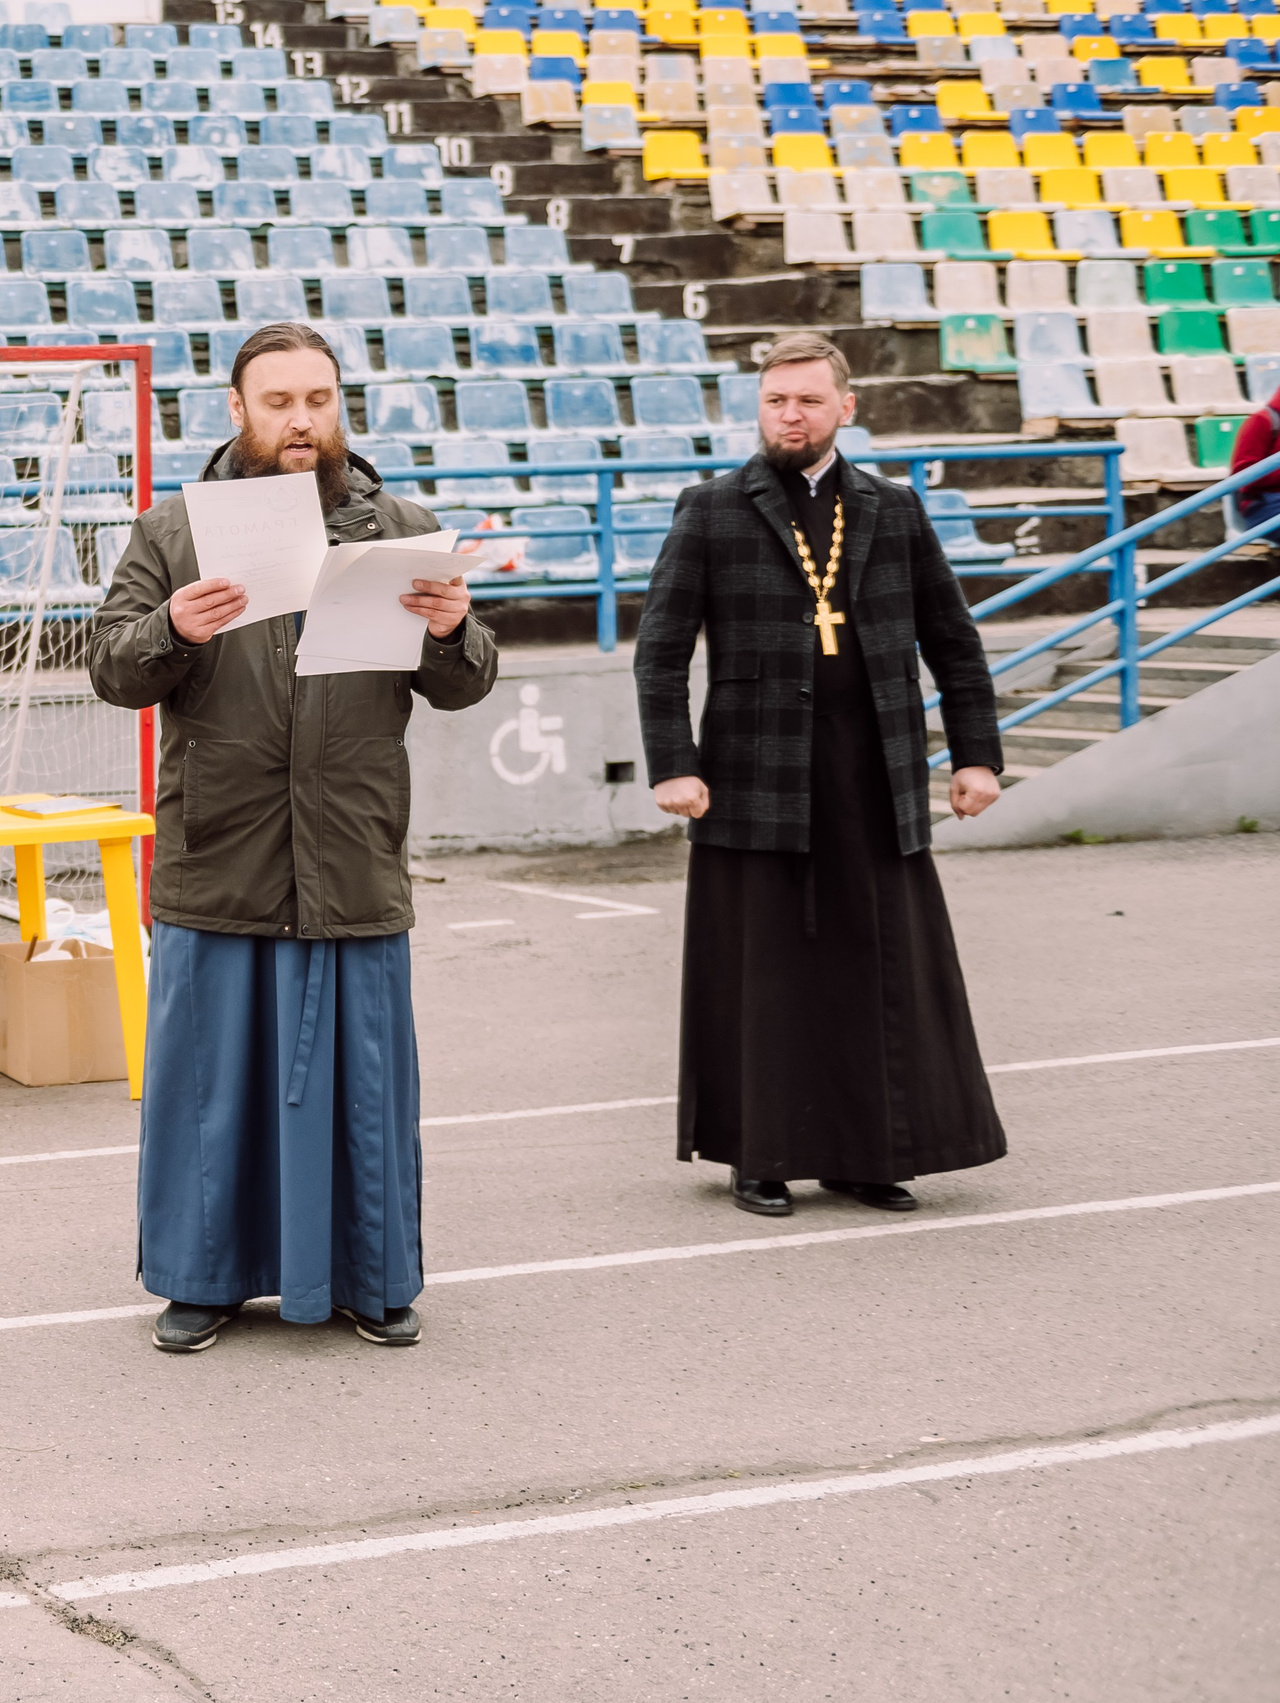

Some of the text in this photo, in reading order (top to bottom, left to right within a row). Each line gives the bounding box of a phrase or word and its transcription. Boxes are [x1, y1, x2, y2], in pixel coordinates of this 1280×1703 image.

[250, 22, 283, 49] 14
[290, 50, 324, 78] 13
[335, 76, 370, 104] 12
[383, 102, 413, 135] 11
[434, 136, 472, 167] 10
[490, 163, 515, 197] 9
[545, 198, 571, 231] 8
[611, 235, 636, 264] 7
[682, 283, 709, 321] 6
